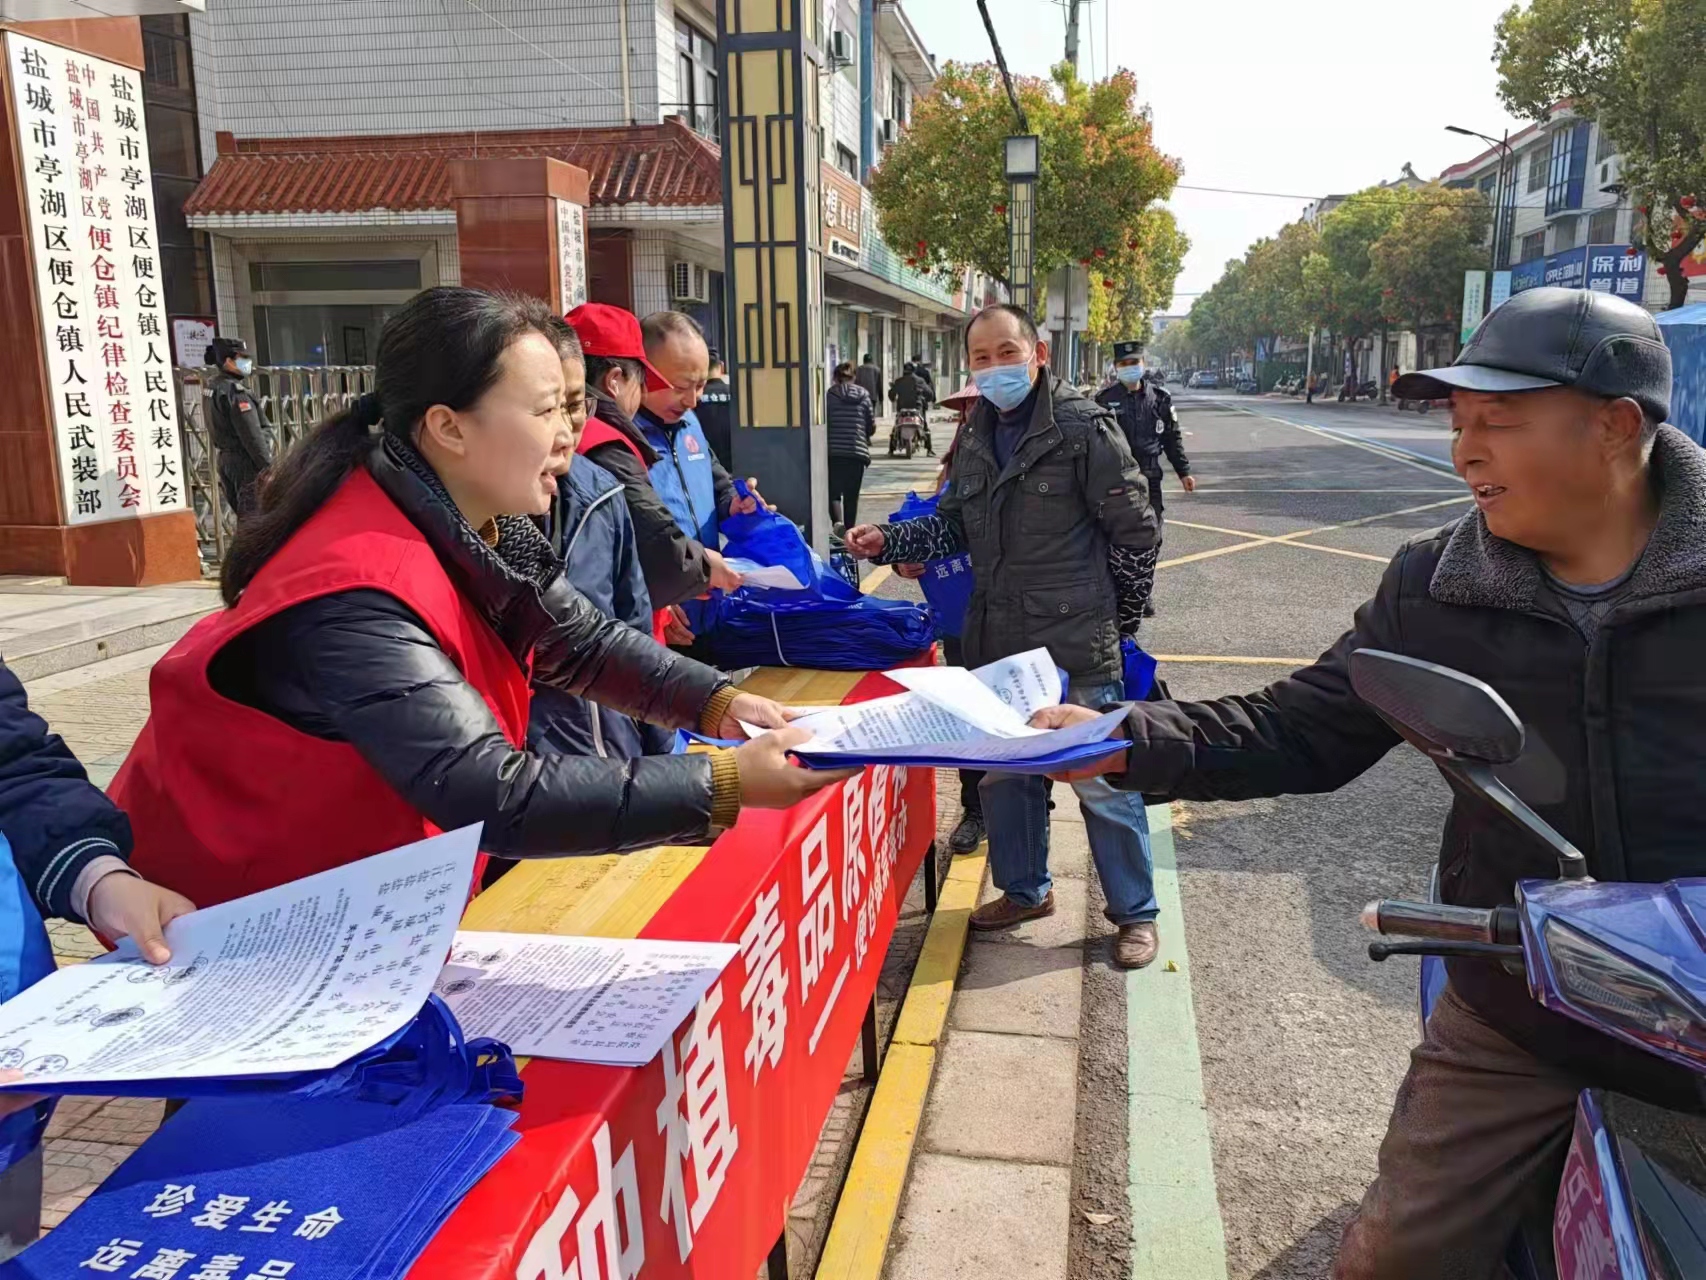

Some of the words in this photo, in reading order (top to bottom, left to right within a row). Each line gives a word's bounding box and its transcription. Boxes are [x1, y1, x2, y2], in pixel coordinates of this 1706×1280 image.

[65, 59, 97, 218] 盐城市亭湖区
[82, 63, 113, 220] 中国共产党
[20, 46, 101, 516] 盐城市亭湖区便仓镇人民武装部
[110, 73, 178, 505] 盐城市亭湖区便仓镇人民代表大会
[1590, 277, 1639, 294] 管道
[1592, 255, 1643, 273] 保利
[88, 224, 142, 509] 便仓镇纪律检查委员会
[79, 1238, 295, 1280] 远离毒品
[143, 1184, 344, 1240] 珍爱生命
